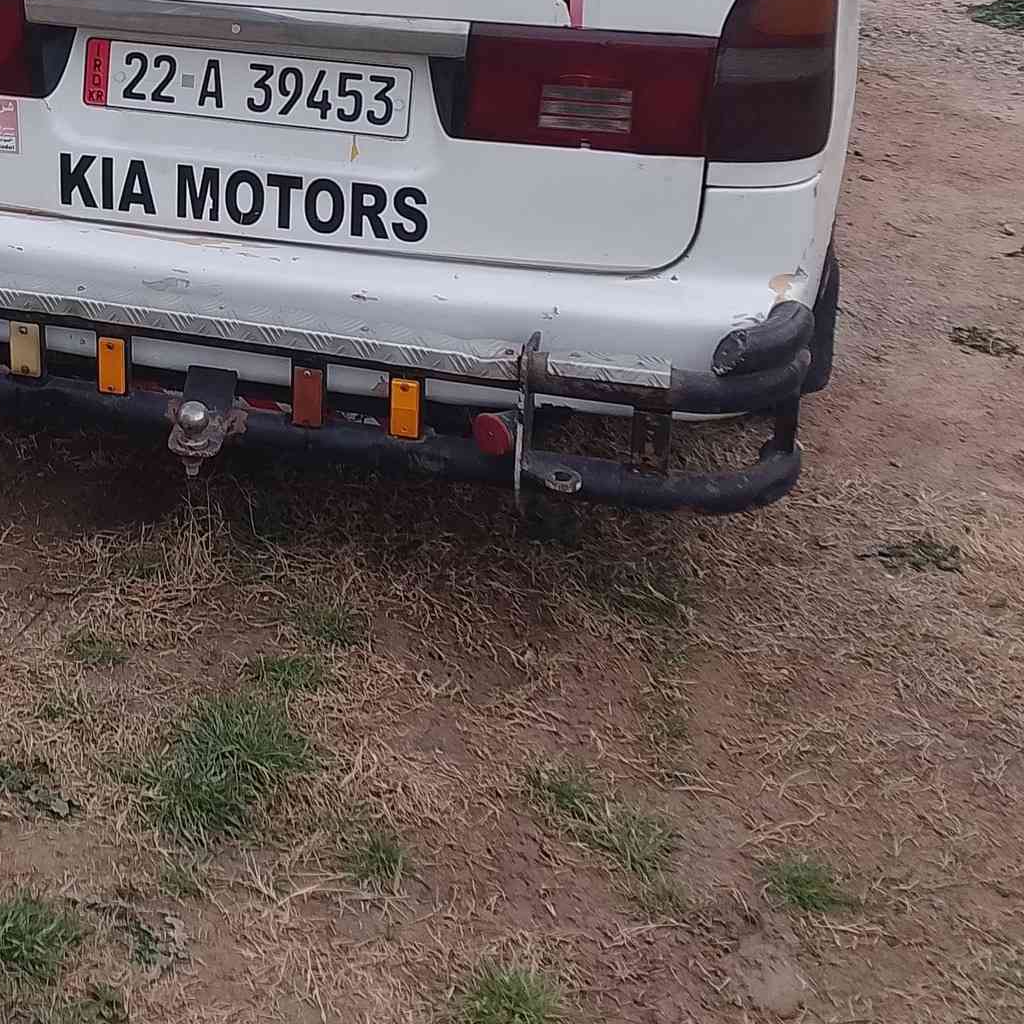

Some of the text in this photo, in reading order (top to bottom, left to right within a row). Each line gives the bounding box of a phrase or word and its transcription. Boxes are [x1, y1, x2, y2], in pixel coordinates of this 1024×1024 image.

[123, 52, 395, 126] 22 A 39453
[59, 153, 429, 243] KIA MOTORS
